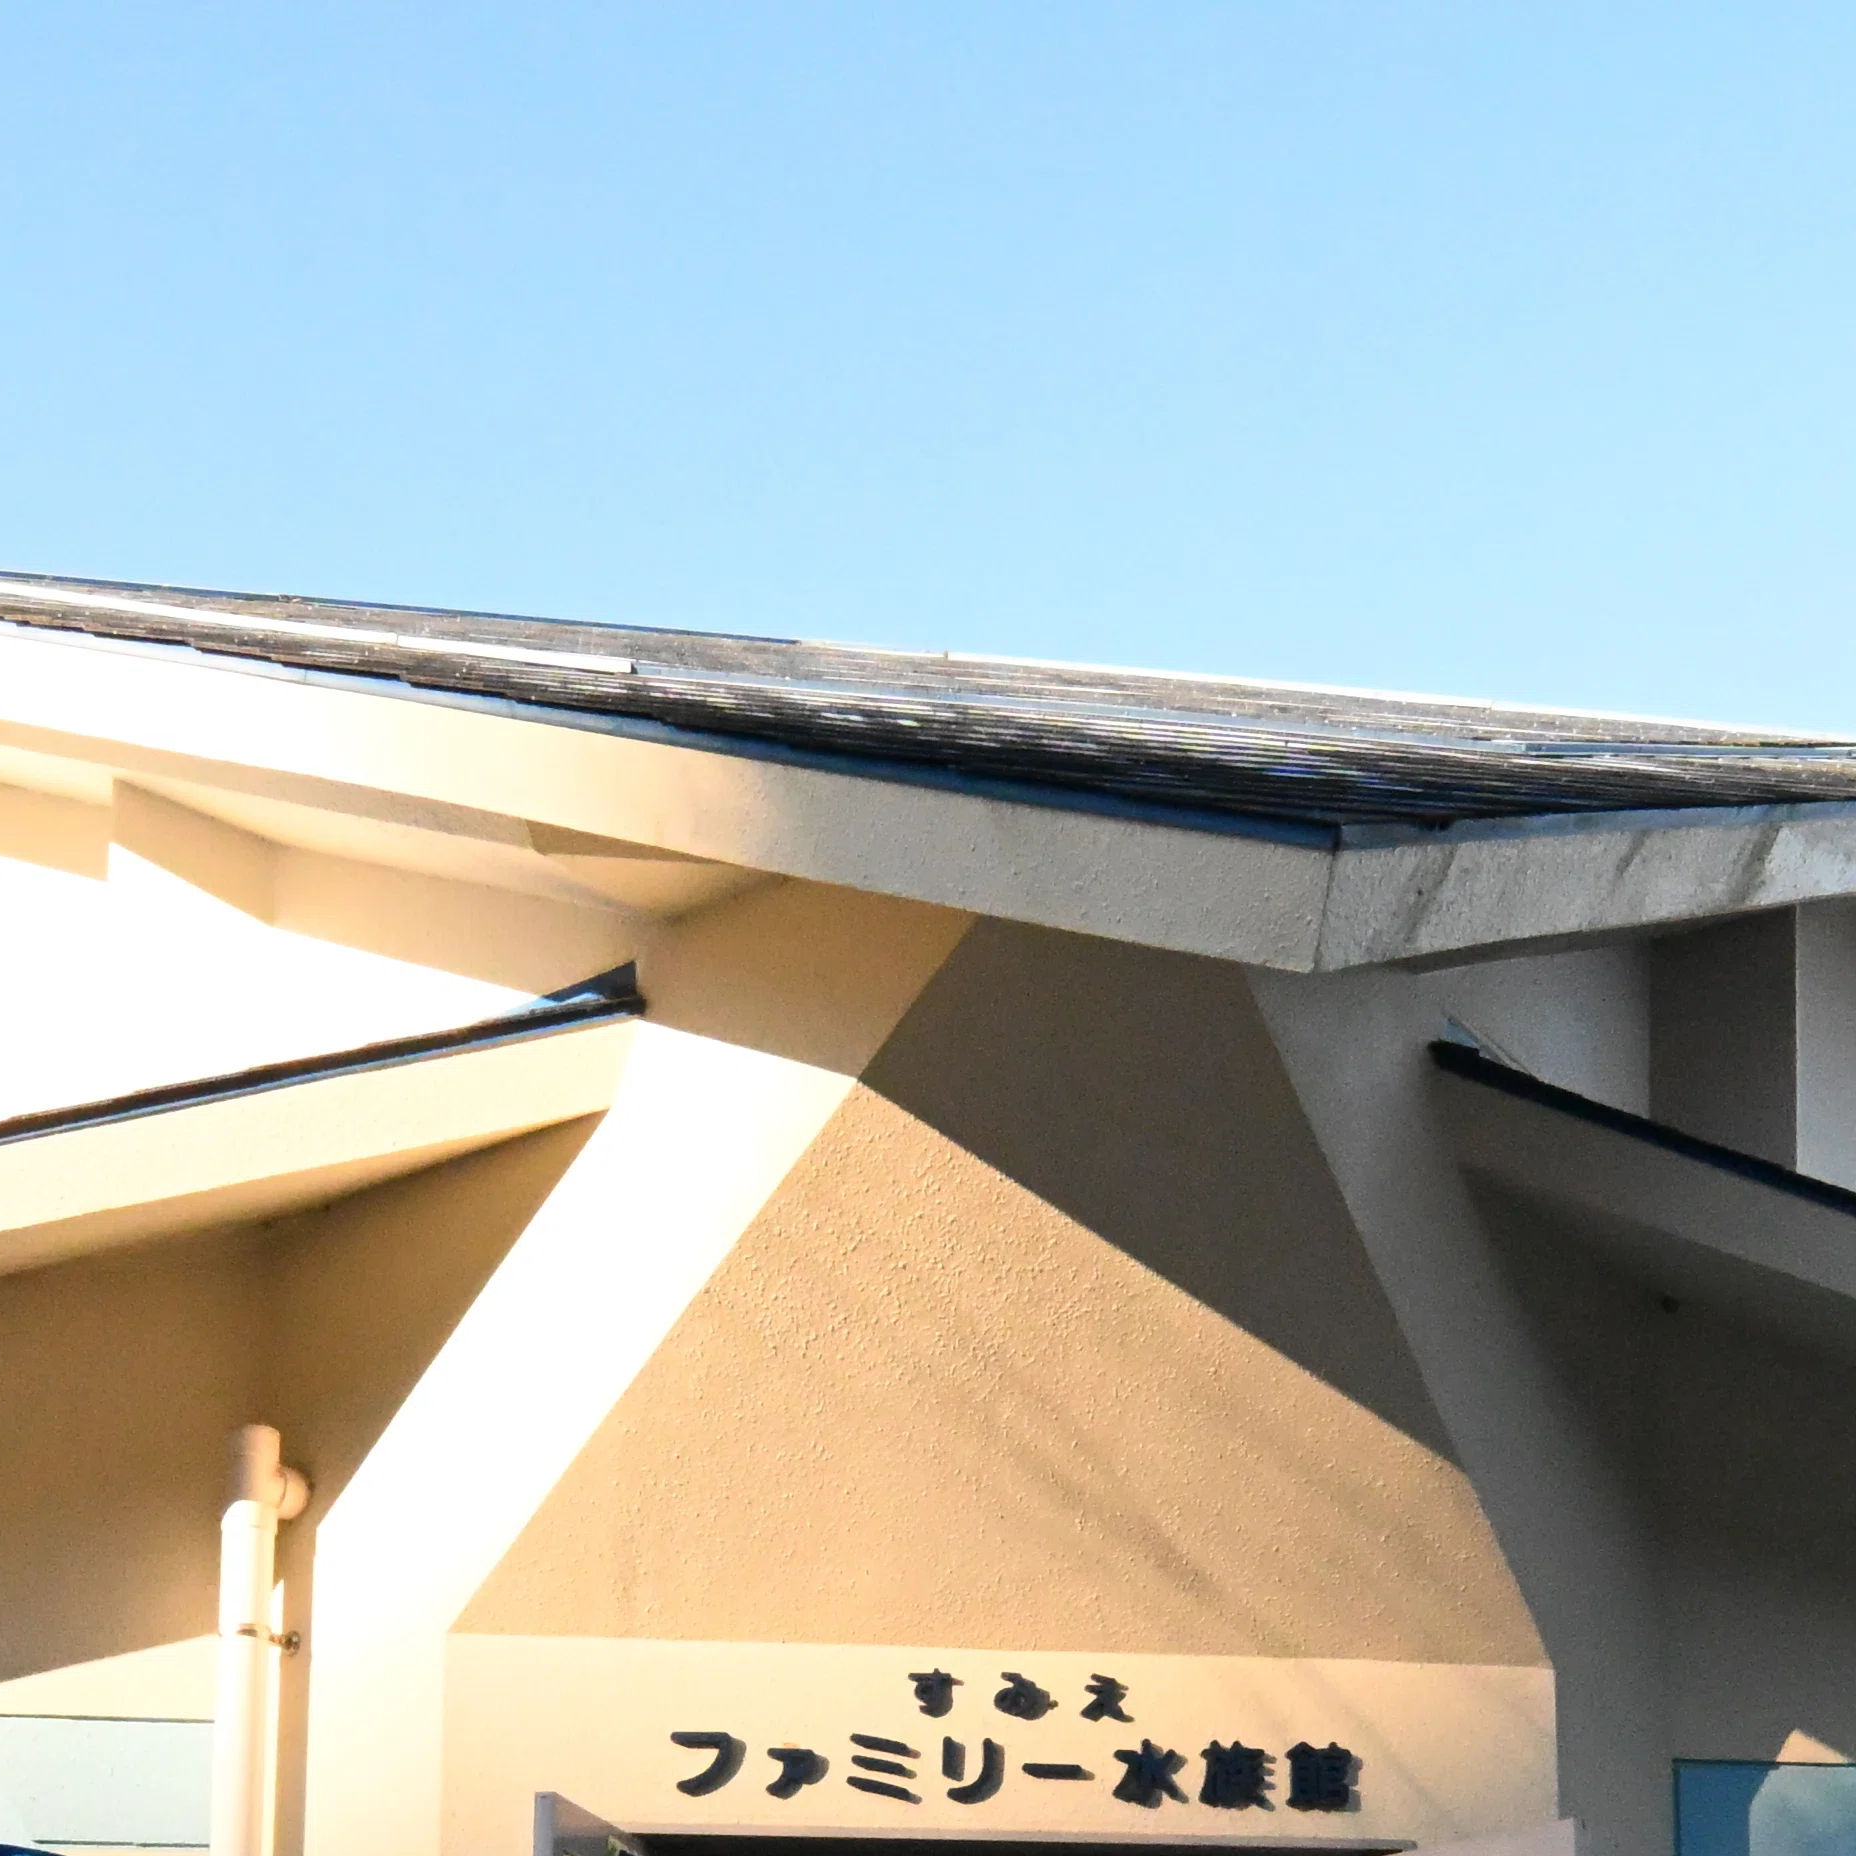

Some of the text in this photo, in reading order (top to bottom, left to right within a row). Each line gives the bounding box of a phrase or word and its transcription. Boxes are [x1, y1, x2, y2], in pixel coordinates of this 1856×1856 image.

[908, 1668, 1134, 1723] すみえ
[670, 1731, 1362, 1813] ファミリー水族館
